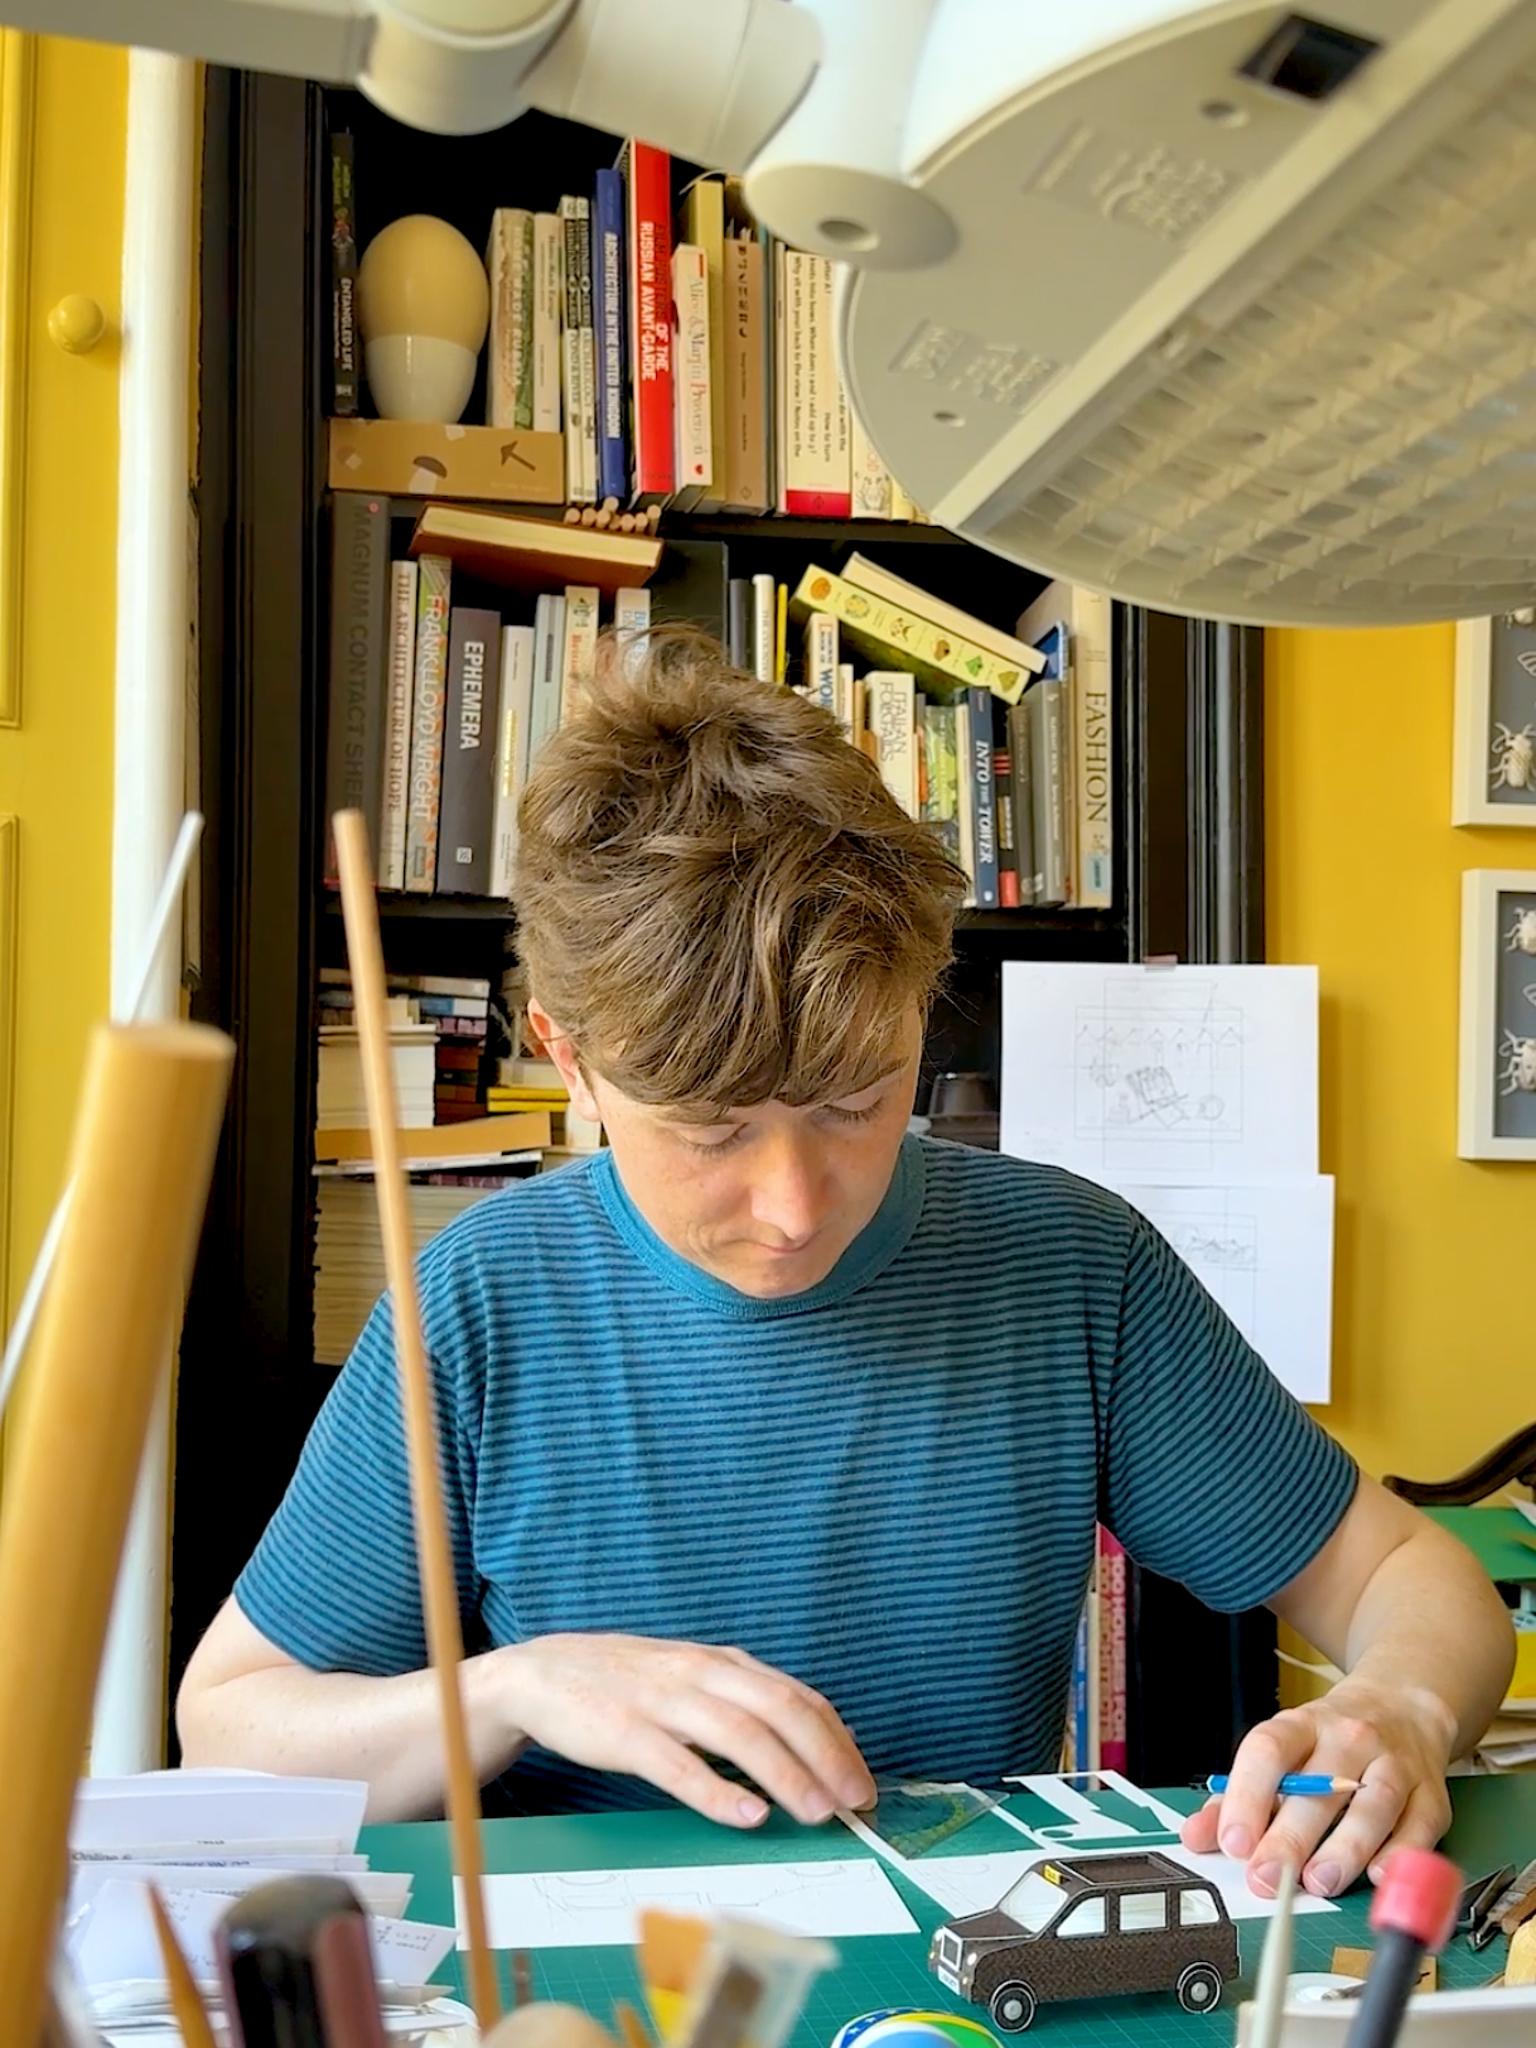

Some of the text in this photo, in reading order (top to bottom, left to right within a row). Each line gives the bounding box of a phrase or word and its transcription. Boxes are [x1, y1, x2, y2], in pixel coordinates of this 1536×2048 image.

[604, 232, 618, 313] ARCHITECTURE
[640, 222, 656, 381] RUSSIAN AVANT-GARDE
[341, 278, 353, 346] ENTANGLED
[605, 314, 618, 325] IN
[606, 326, 619, 346] THE
[656, 323, 669, 343] OF
[342, 346, 354, 371] LIFE
[606, 348, 620, 385] UNITED
[656, 345, 669, 371] THE
[607, 388, 620, 438] KINGDOM
[344, 504, 372, 809] MAGNUM CONTACT SHEE
[420, 593, 442, 666] FRANK
[388, 573, 411, 813] THE ARCHITECTURE OF HOPE
[415, 667, 438, 736] LLOYD
[459, 641, 485, 750] EPHEMERA
[893, 691, 907, 754] ITALIAN
[413, 737, 435, 822] WRIGHT
[1085, 691, 1108, 823] FASHION
[975, 740, 994, 864] INTO THE TOWER
